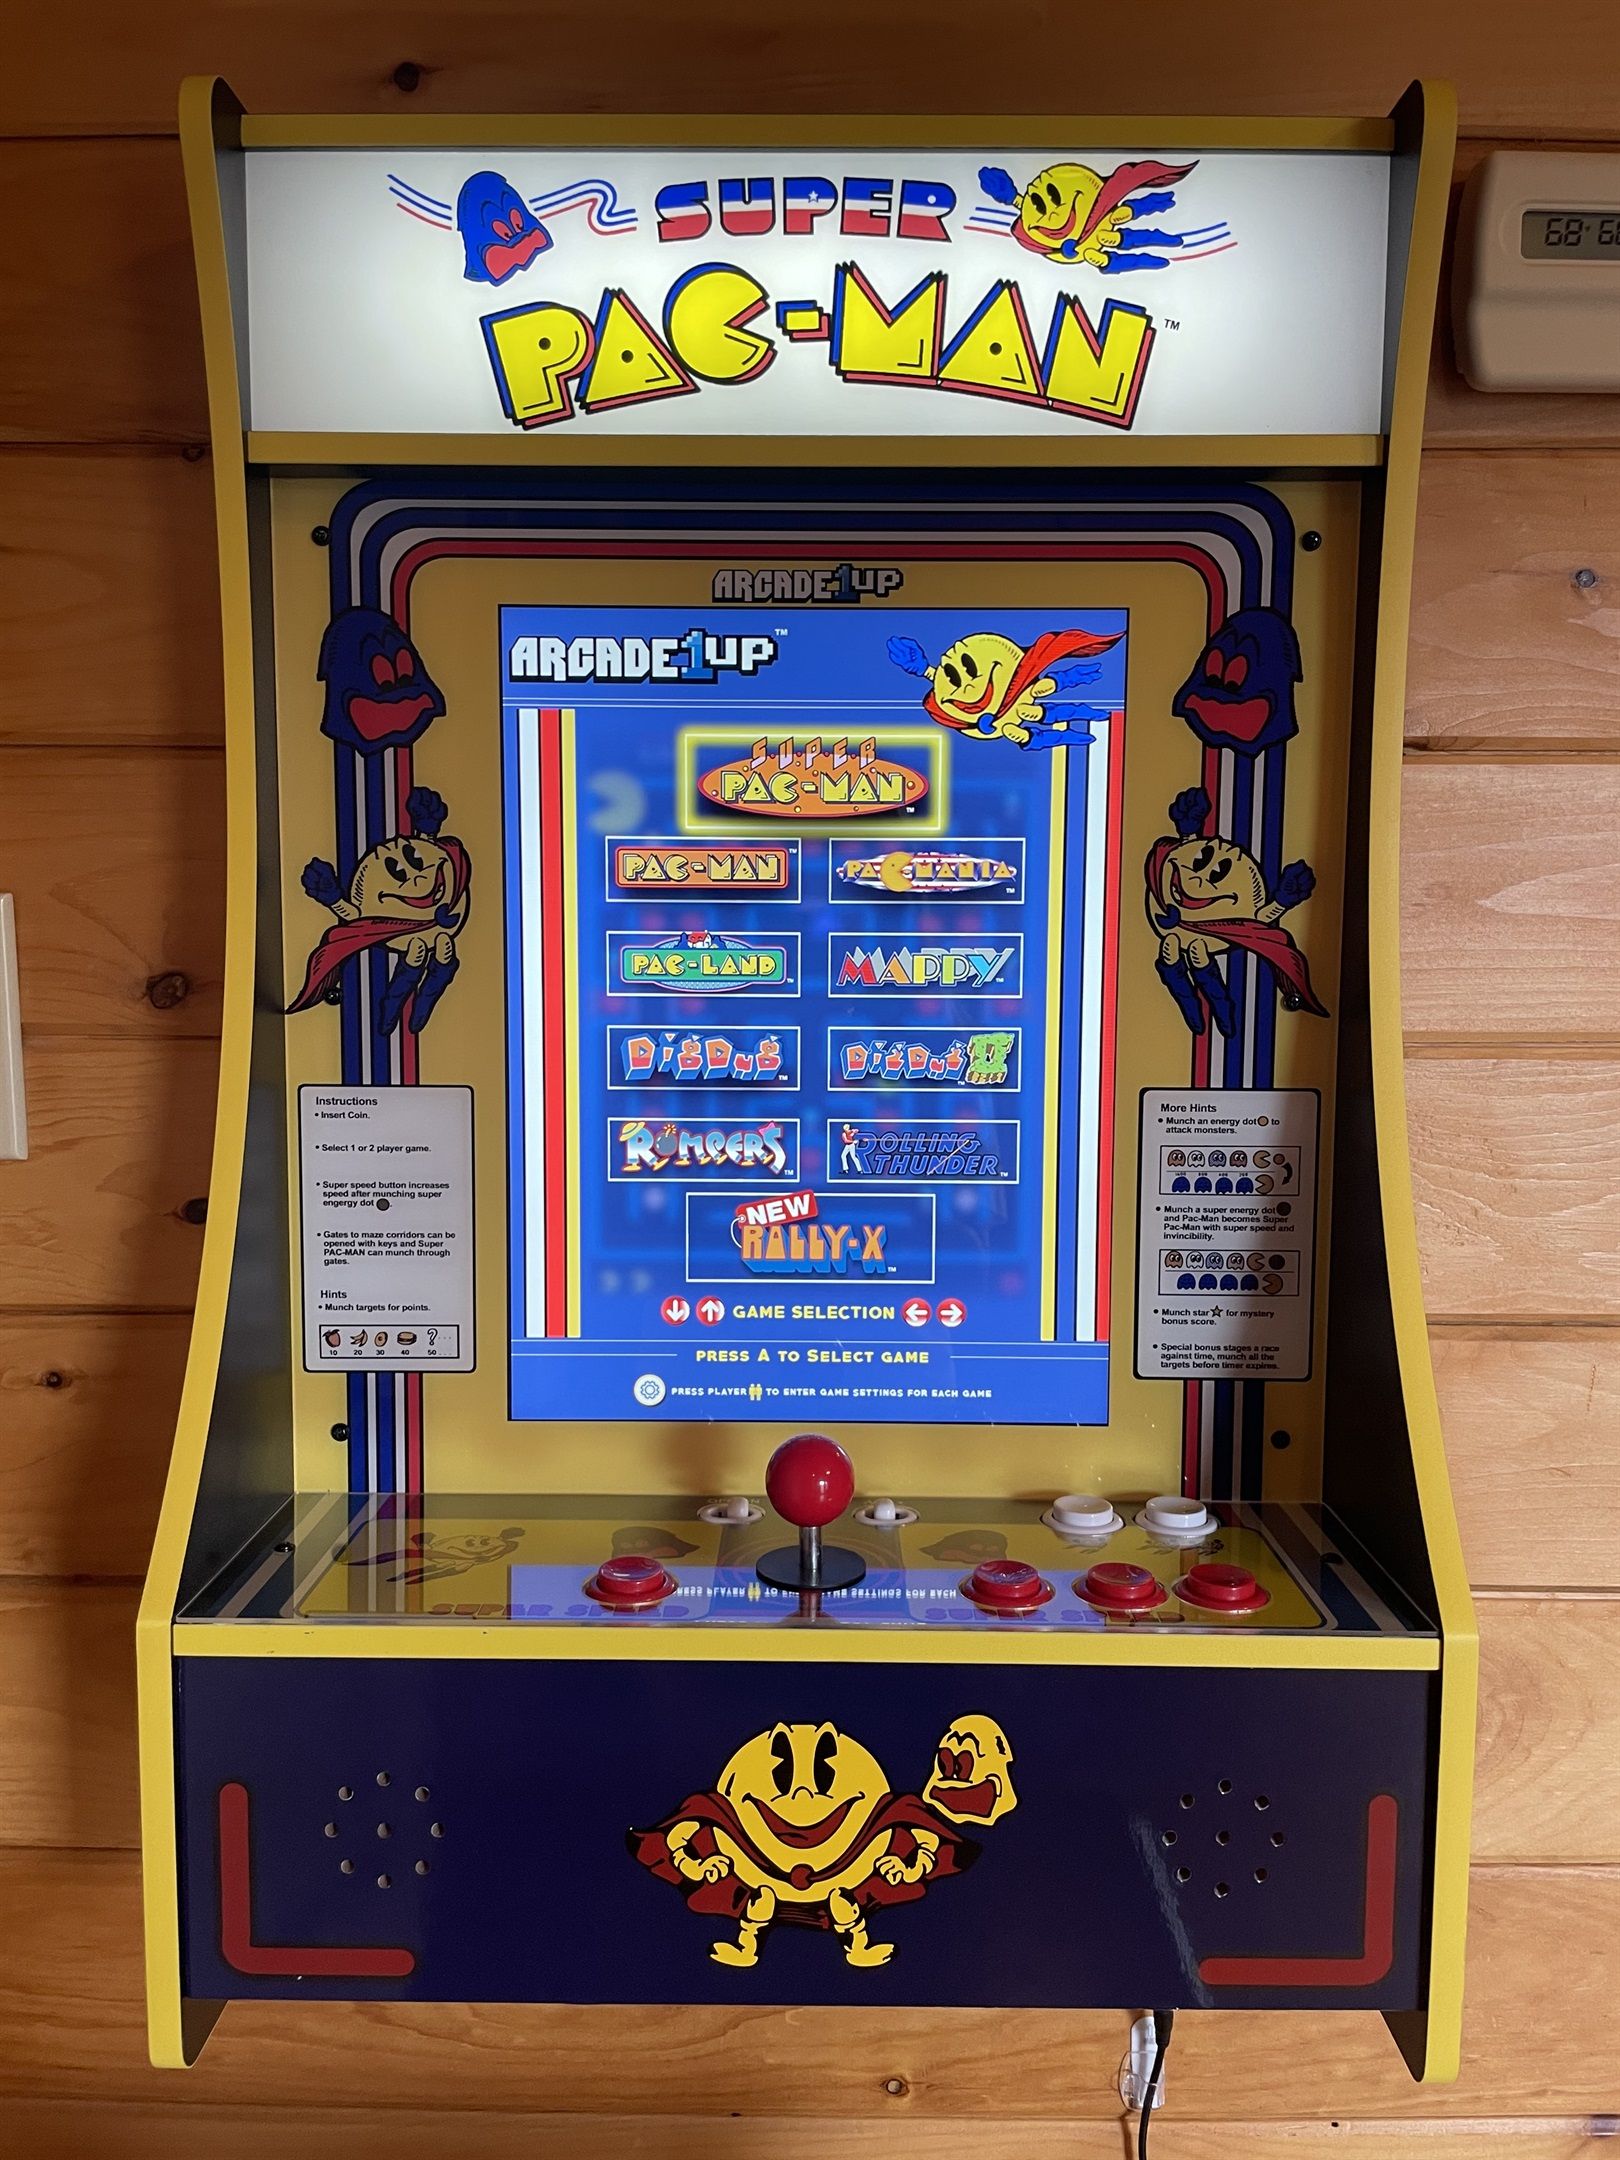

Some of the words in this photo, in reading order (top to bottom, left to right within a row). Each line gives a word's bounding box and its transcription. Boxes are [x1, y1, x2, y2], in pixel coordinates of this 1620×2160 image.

[657, 175, 956, 243] SUPER
[480, 261, 1156, 430] PAC-MAN
[712, 563, 903, 603] ARCADE1UP
[509, 628, 778, 684] ARCADE1UP
[750, 736, 876, 770] SUPER
[721, 771, 905, 804] PAC-MAN
[622, 852, 782, 883] PAC-MAN
[631, 952, 776, 977] PAC-LAND
[837, 946, 1014, 987] MAPPY
[316, 1096, 377, 1105] Instructions
[1161, 1103, 1186, 1112] More
[1190, 1104, 1217, 1112] Hints
[321, 1111, 345, 1119] Insert
[348, 1111, 370, 1119] Coin.
[1210, 1119, 1240, 1127] energy
[1194, 1126, 1237, 1134] monsters.
[377, 1145, 403, 1153] player
[853, 1131, 981, 1175] ROLLING
[874, 1154, 998, 1175] THUNDER
[323, 1181, 348, 1190] Super
[350, 1182, 376, 1191] speed
[323, 1189, 348, 1199] speed
[351, 1189, 370, 1197] after
[373, 1190, 415, 1200] munching
[746, 1194, 810, 1225] NEW
[1202, 1208, 1227, 1216] super
[1230, 1208, 1260, 1216] energy
[1261, 1205, 1276, 1215] dot
[1182, 1214, 1219, 1222] Pac-Man
[1222, 1215, 1262, 1224] becomes
[1263, 1215, 1289, 1225] Super
[1164, 1223, 1200, 1231] Pac-Man
[1250, 1224, 1277, 1234] speed
[1164, 1233, 1214, 1241] invincibility.
[324, 1240, 355, 1248] opened
[378, 1240, 398, 1249] keys
[418, 1240, 444, 1249] Super
[742, 1224, 887, 1274] RALLY-X
[385, 1248, 414, 1256] munch
[417, 1248, 450, 1258] through
[324, 1258, 349, 1266] gates.
[321, 1290, 347, 1298] Hints
[356, 1304, 385, 1312] targets
[402, 1304, 430, 1312] points.
[732, 1305, 785, 1318] GAME
[792, 1306, 895, 1320] SELECTION
[1240, 1310, 1275, 1319] mystery
[1162, 1317, 1188, 1325] bonus
[1161, 1343, 1192, 1353] Special
[1223, 1344, 1253, 1354] stages
[696, 1350, 750, 1363] PRESS
[758, 1349, 770, 1362] A
[778, 1351, 800, 1362] TO
[881, 1352, 929, 1364] GAME
[1161, 1352, 1192, 1362] against
[1193, 1352, 1215, 1362] time,
[1217, 1352, 1247, 1362] munch
[1248, 1352, 1260, 1360] all
[1161, 1360, 1190, 1369] targets
[1193, 1361, 1221, 1370] before
[1222, 1361, 1244, 1370] timer
[671, 1387, 704, 1395] PRESS
[708, 1387, 747, 1396] PLAYER
[766, 1388, 779, 1396] TO
[783, 1388, 816, 1396] ENTER
[820, 1388, 849, 1396] GAME
[853, 1389, 903, 1397] SETTINGS
[907, 1389, 927, 1397] FOR
[931, 1389, 958, 1397] EACH
